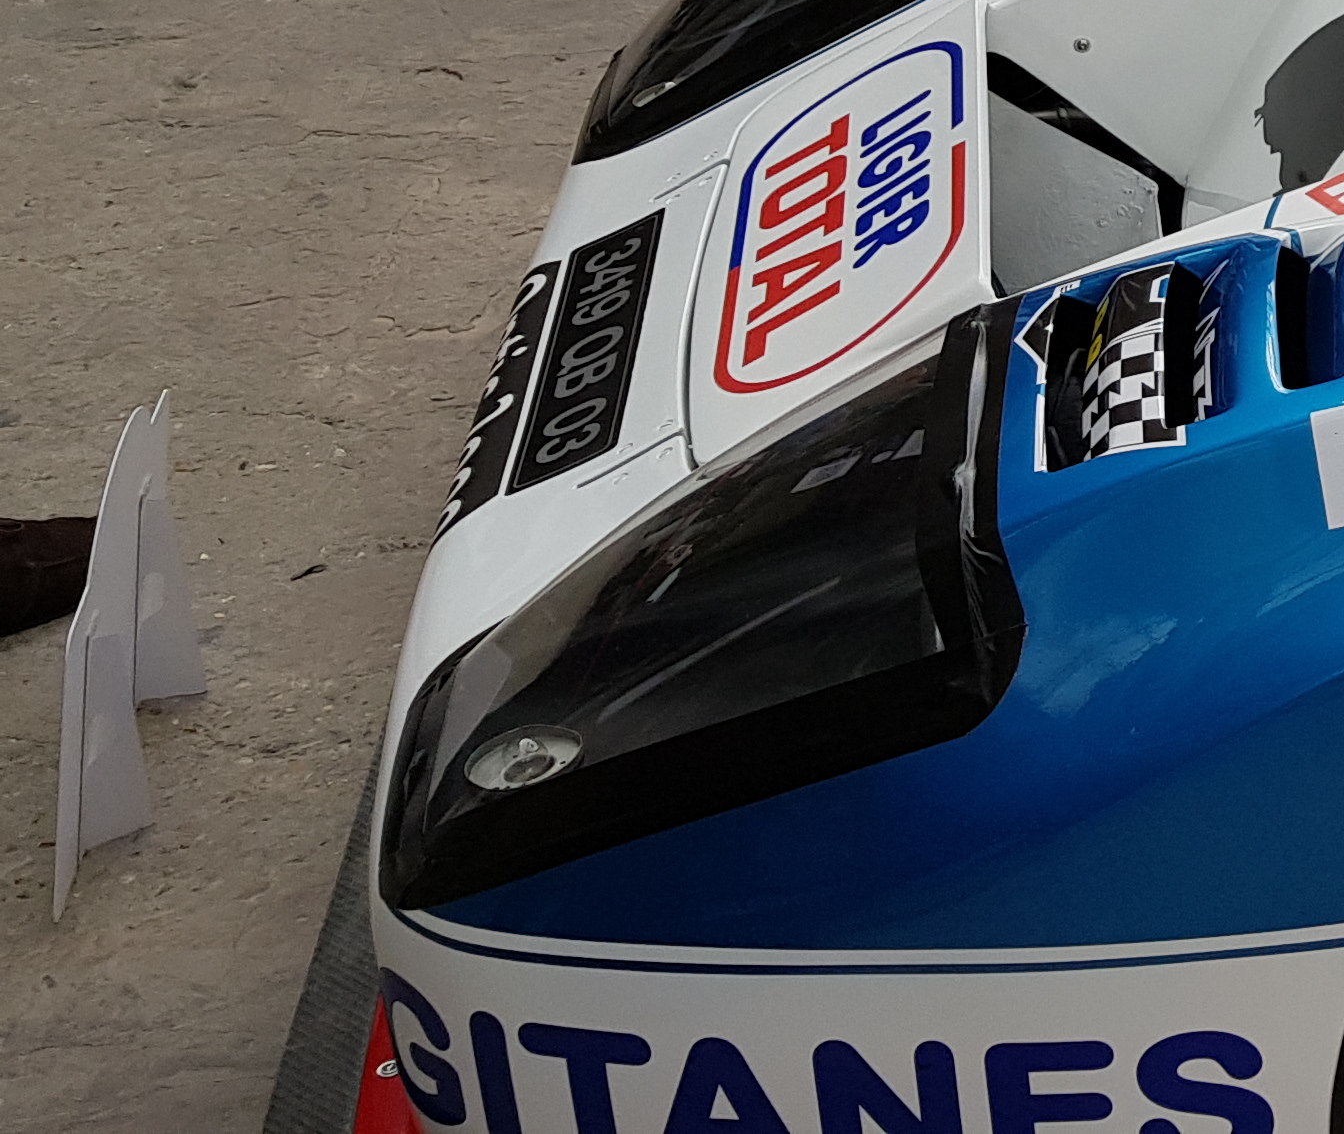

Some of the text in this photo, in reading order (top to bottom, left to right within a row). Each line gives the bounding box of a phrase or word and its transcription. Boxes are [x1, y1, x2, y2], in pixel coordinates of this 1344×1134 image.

[742, 112, 851, 368] TOTAL
[853, 88, 932, 270] LIGIER
[535, 396, 608, 464] 03
[379, 967, 1276, 1134] GITANES
